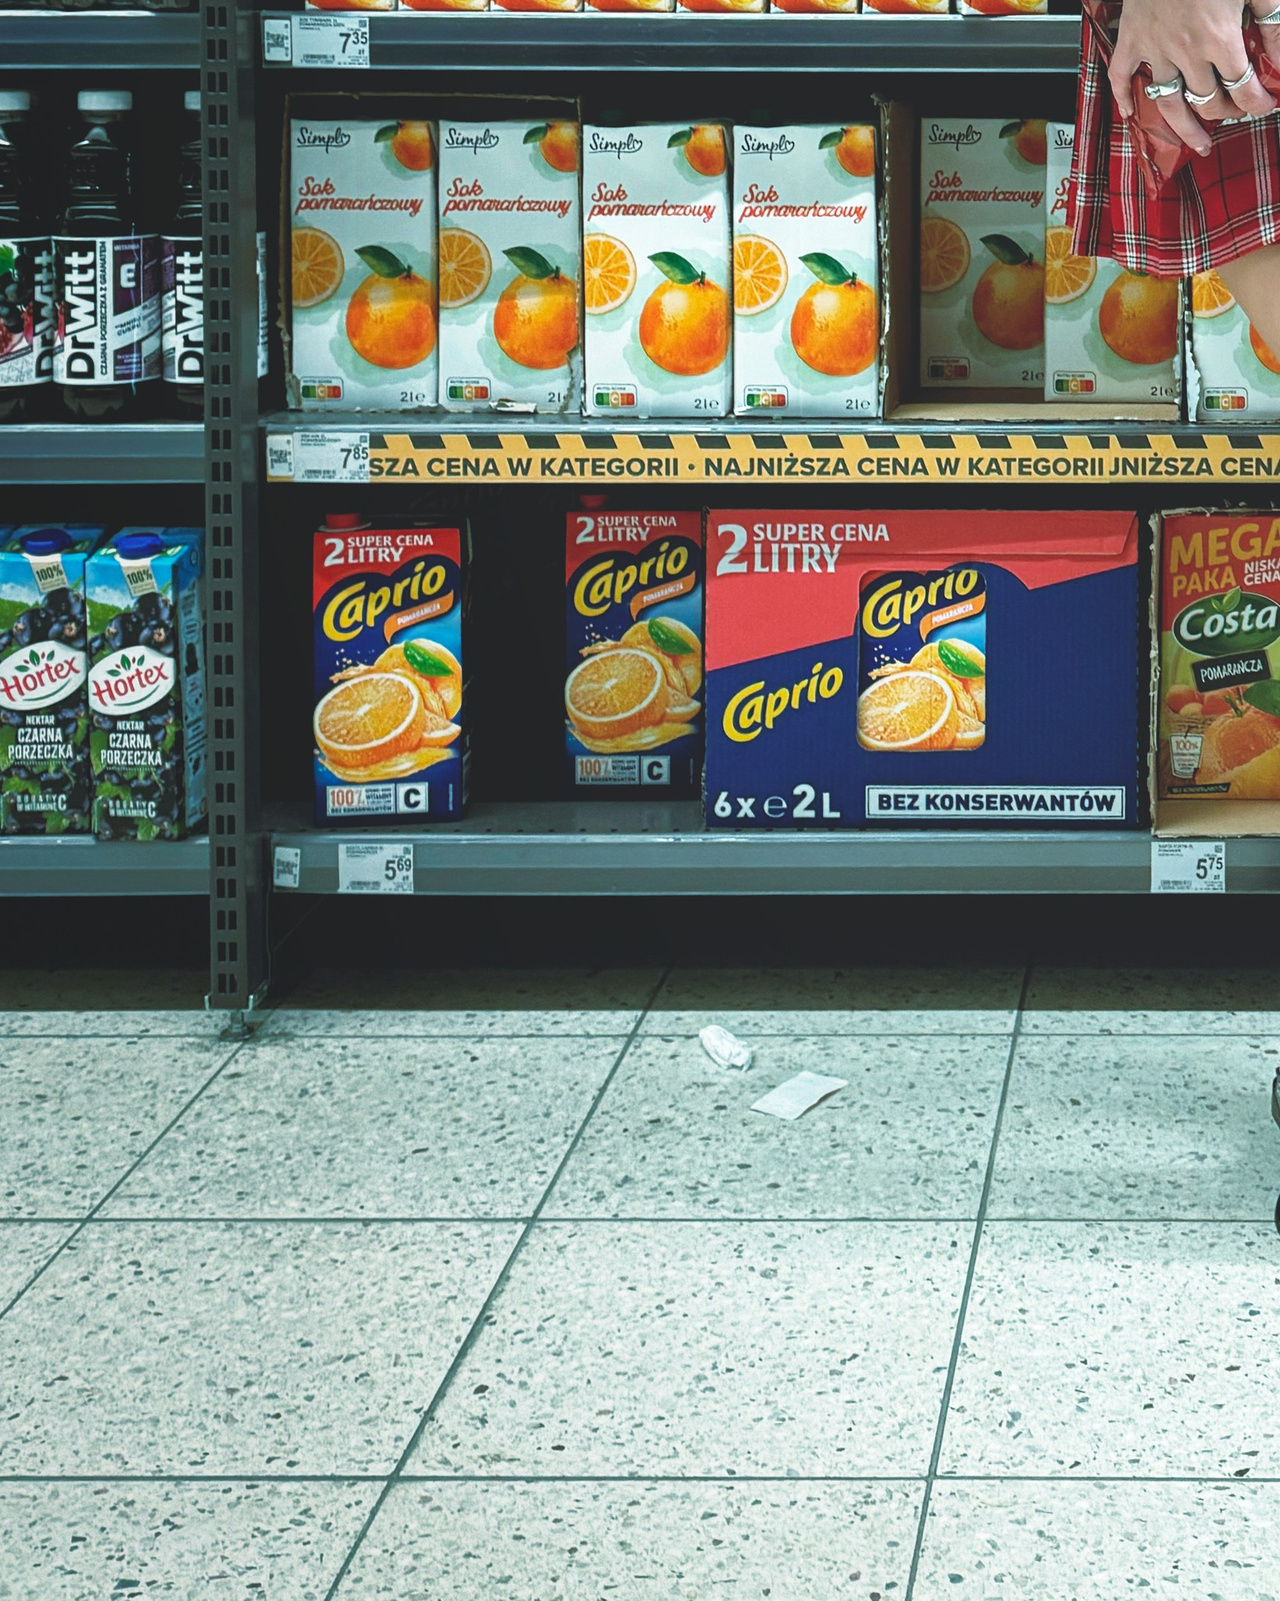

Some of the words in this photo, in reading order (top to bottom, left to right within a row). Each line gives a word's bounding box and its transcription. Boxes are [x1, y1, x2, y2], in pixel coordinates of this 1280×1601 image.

[298, 176, 335, 196] Sok
[295, 194, 423, 217] pomarańczowy
[739, 200, 868, 224] pomarańczowy
[426, 457, 501, 477] CENA
[507, 457, 532, 477] W
[540, 457, 679, 477] KATEGORII
[704, 453, 851, 477] NAJNIŻSZA
[857, 456, 929, 477] CENA
[936, 456, 961, 477] W
[968, 456, 1103, 477] KATEGORII
[347, 535, 393, 547] SUPER
[396, 534, 434, 547] CENA
[752, 523, 826, 542] SUPER
[830, 523, 890, 542] CENA
[324, 538, 345, 567] 2
[347, 547, 404, 564] LITRY
[716, 523, 748, 576] 2
[753, 543, 843, 573] LITRY
[1172, 567, 1237, 598] PAKA
[322, 561, 446, 642] Caprio
[861, 569, 979, 638] Caprio
[92, 662, 169, 707] Hortex
[722, 661, 844, 743] Caprio
[109, 733, 152, 750] CZARNA
[100, 749, 163, 767] PORZECZKA
[878, 794, 920, 812] BEZ
[925, 789, 1115, 813] KONSERWANTÓW
